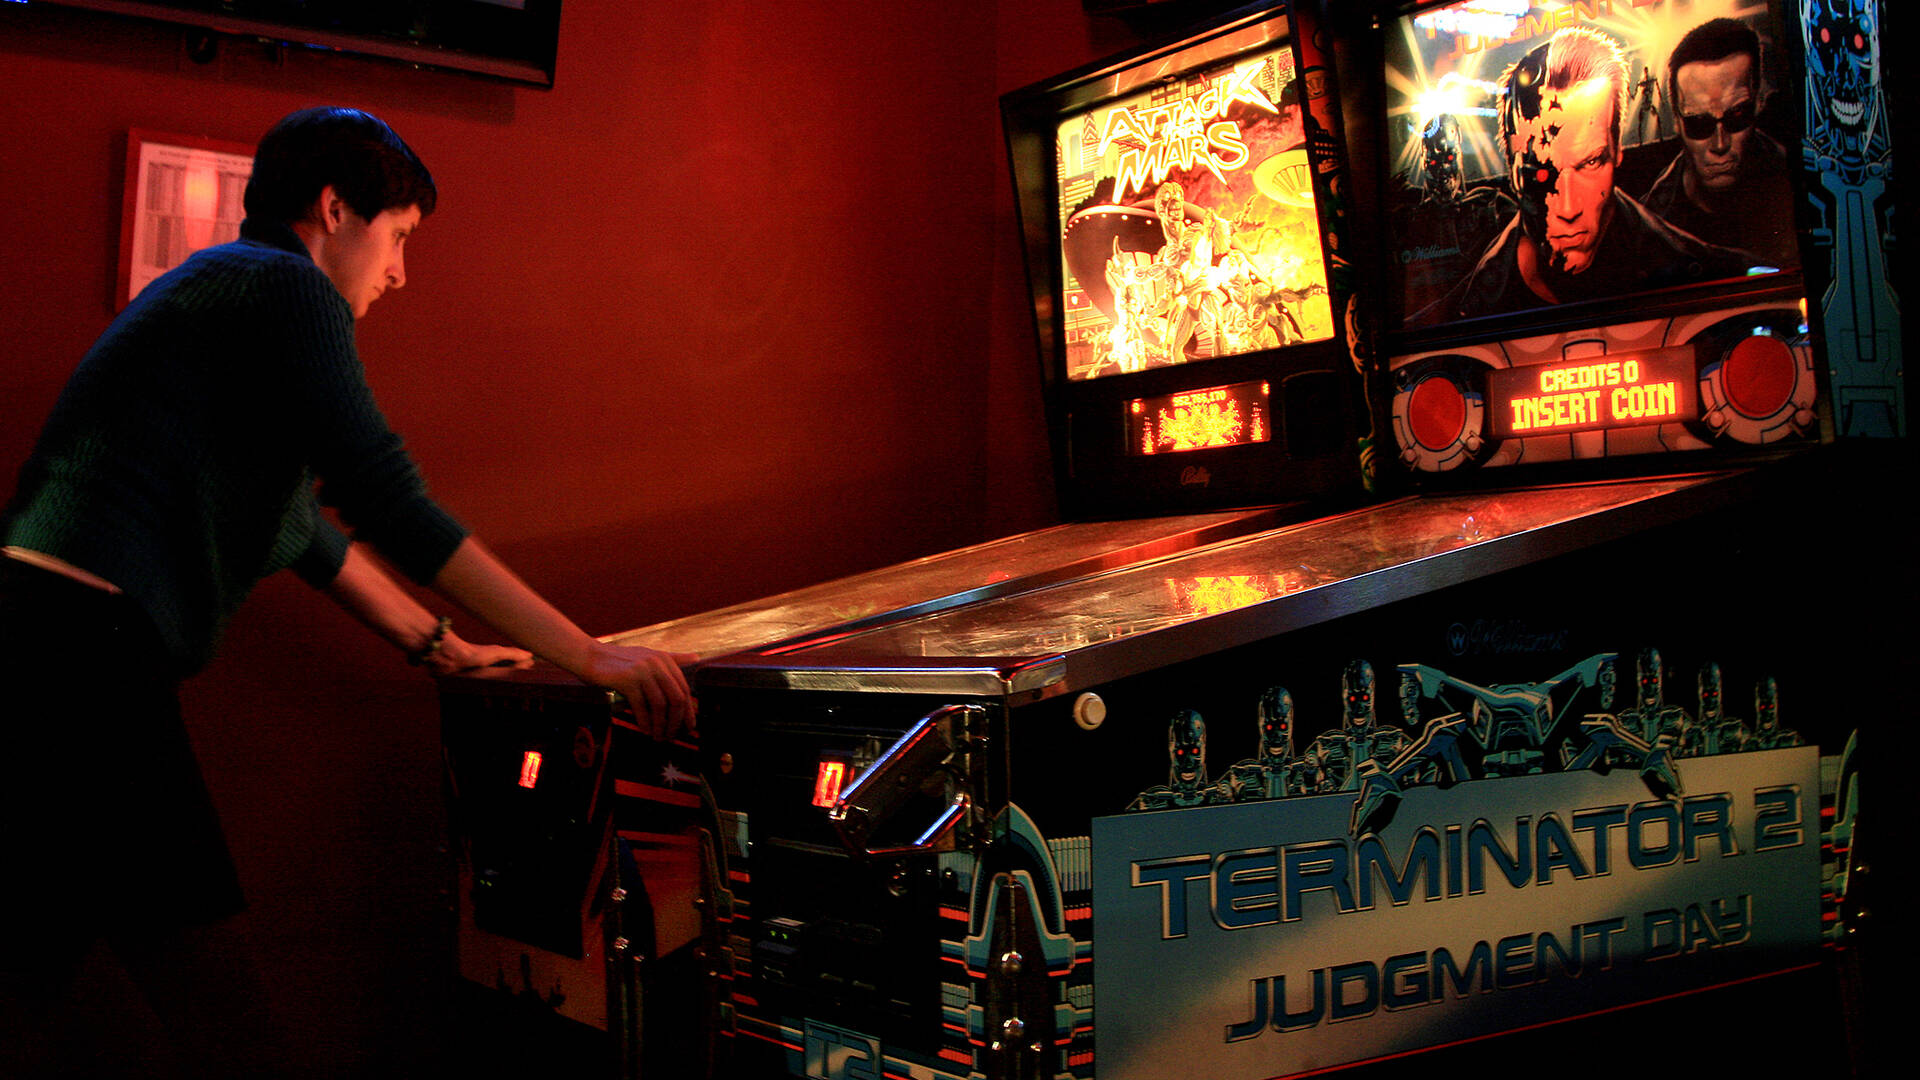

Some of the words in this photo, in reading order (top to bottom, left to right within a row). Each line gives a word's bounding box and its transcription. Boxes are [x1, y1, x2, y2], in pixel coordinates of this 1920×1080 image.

[1098, 59, 1279, 157] ATTACK
[1112, 121, 1250, 204] MARS
[1511, 390, 1600, 430] INSERT
[1611, 382, 1676, 420] COIN
[1540, 362, 1620, 393] CREDITS
[1130, 791, 1740, 940] TERMINATOR
[1754, 784, 1804, 852] 2
[1225, 916, 1628, 1043] JUDGMENT
[1643, 894, 1752, 964] DAY
